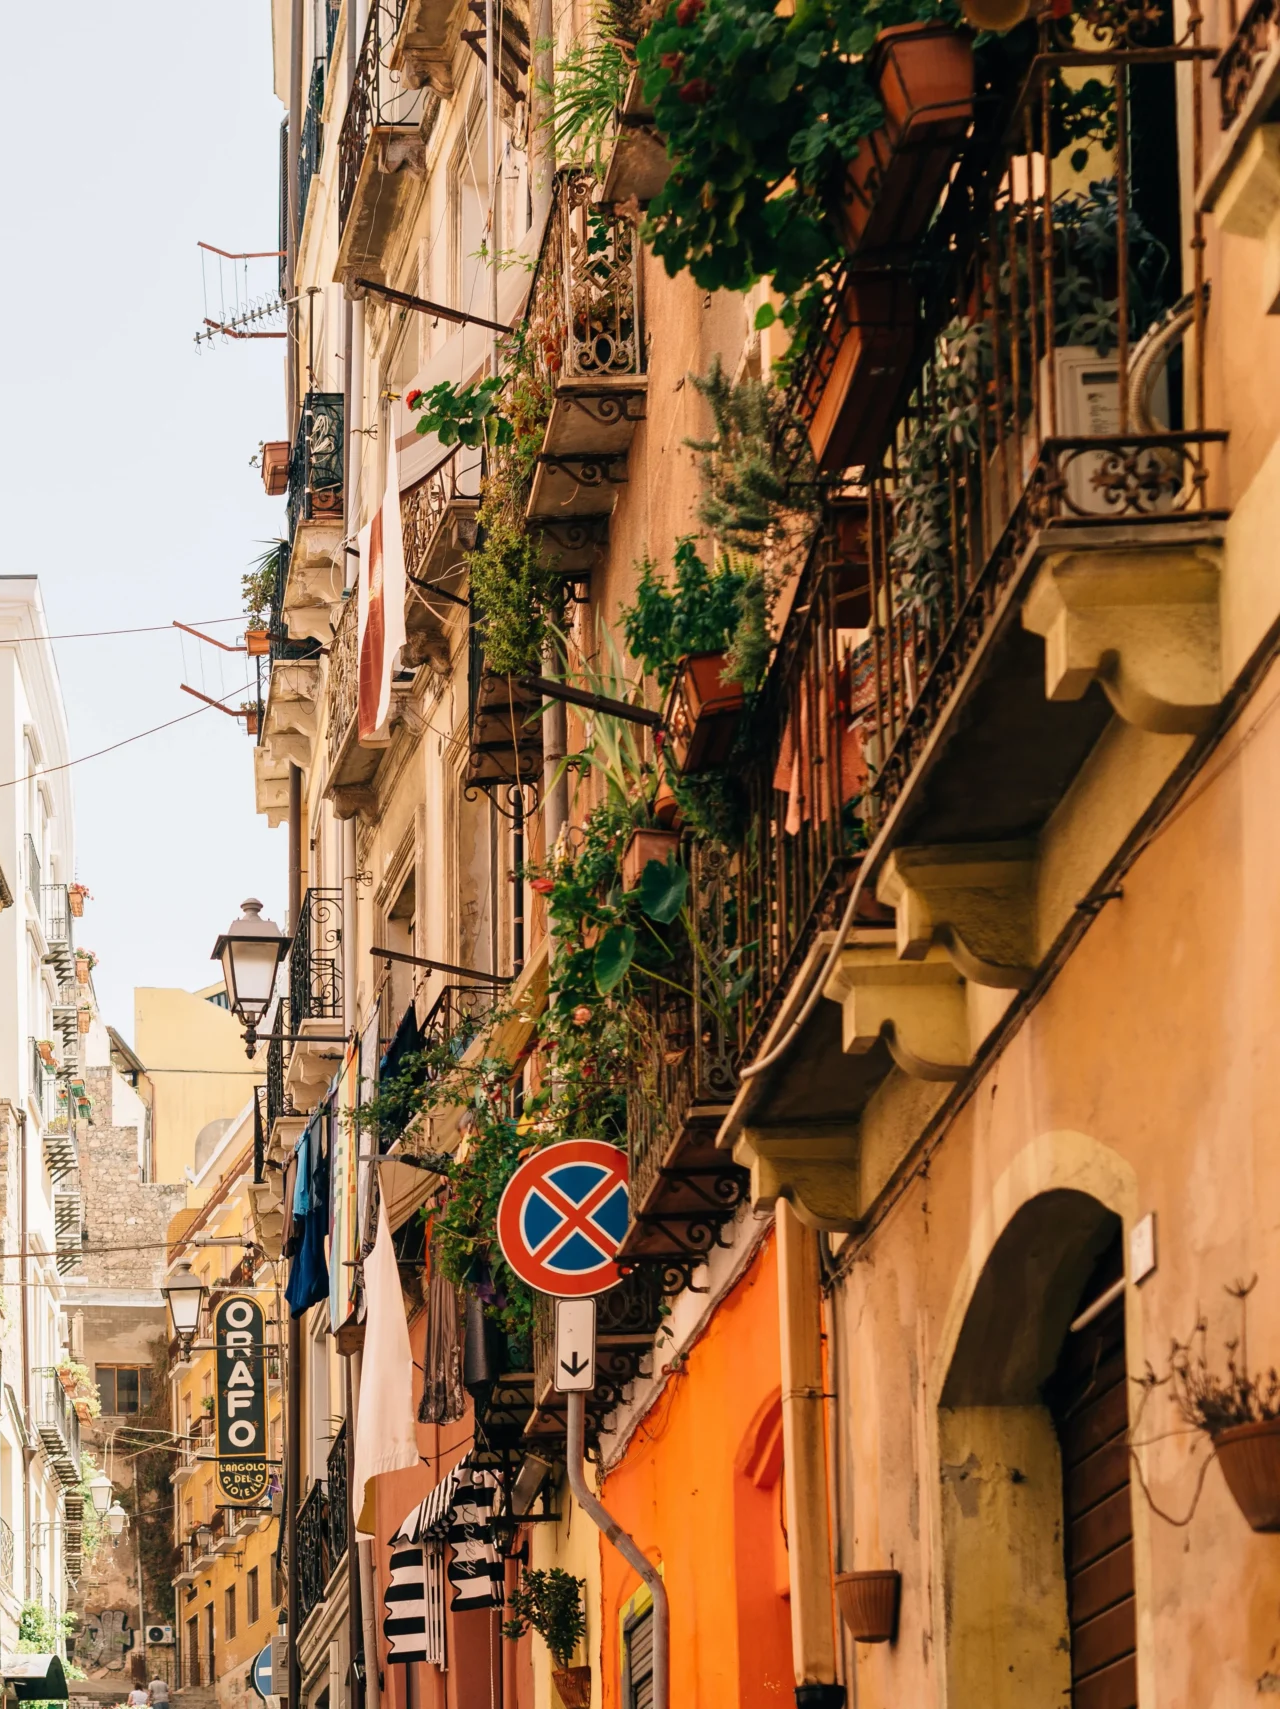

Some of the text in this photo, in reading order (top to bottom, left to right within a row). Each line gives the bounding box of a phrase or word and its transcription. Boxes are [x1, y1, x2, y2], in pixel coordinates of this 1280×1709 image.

[225, 1301, 256, 1447] ORAFO
[223, 1474, 264, 1497] GIOIELLO
[234, 1474, 252, 1483] DEL
[453, 1499, 484, 1576] Bakery
